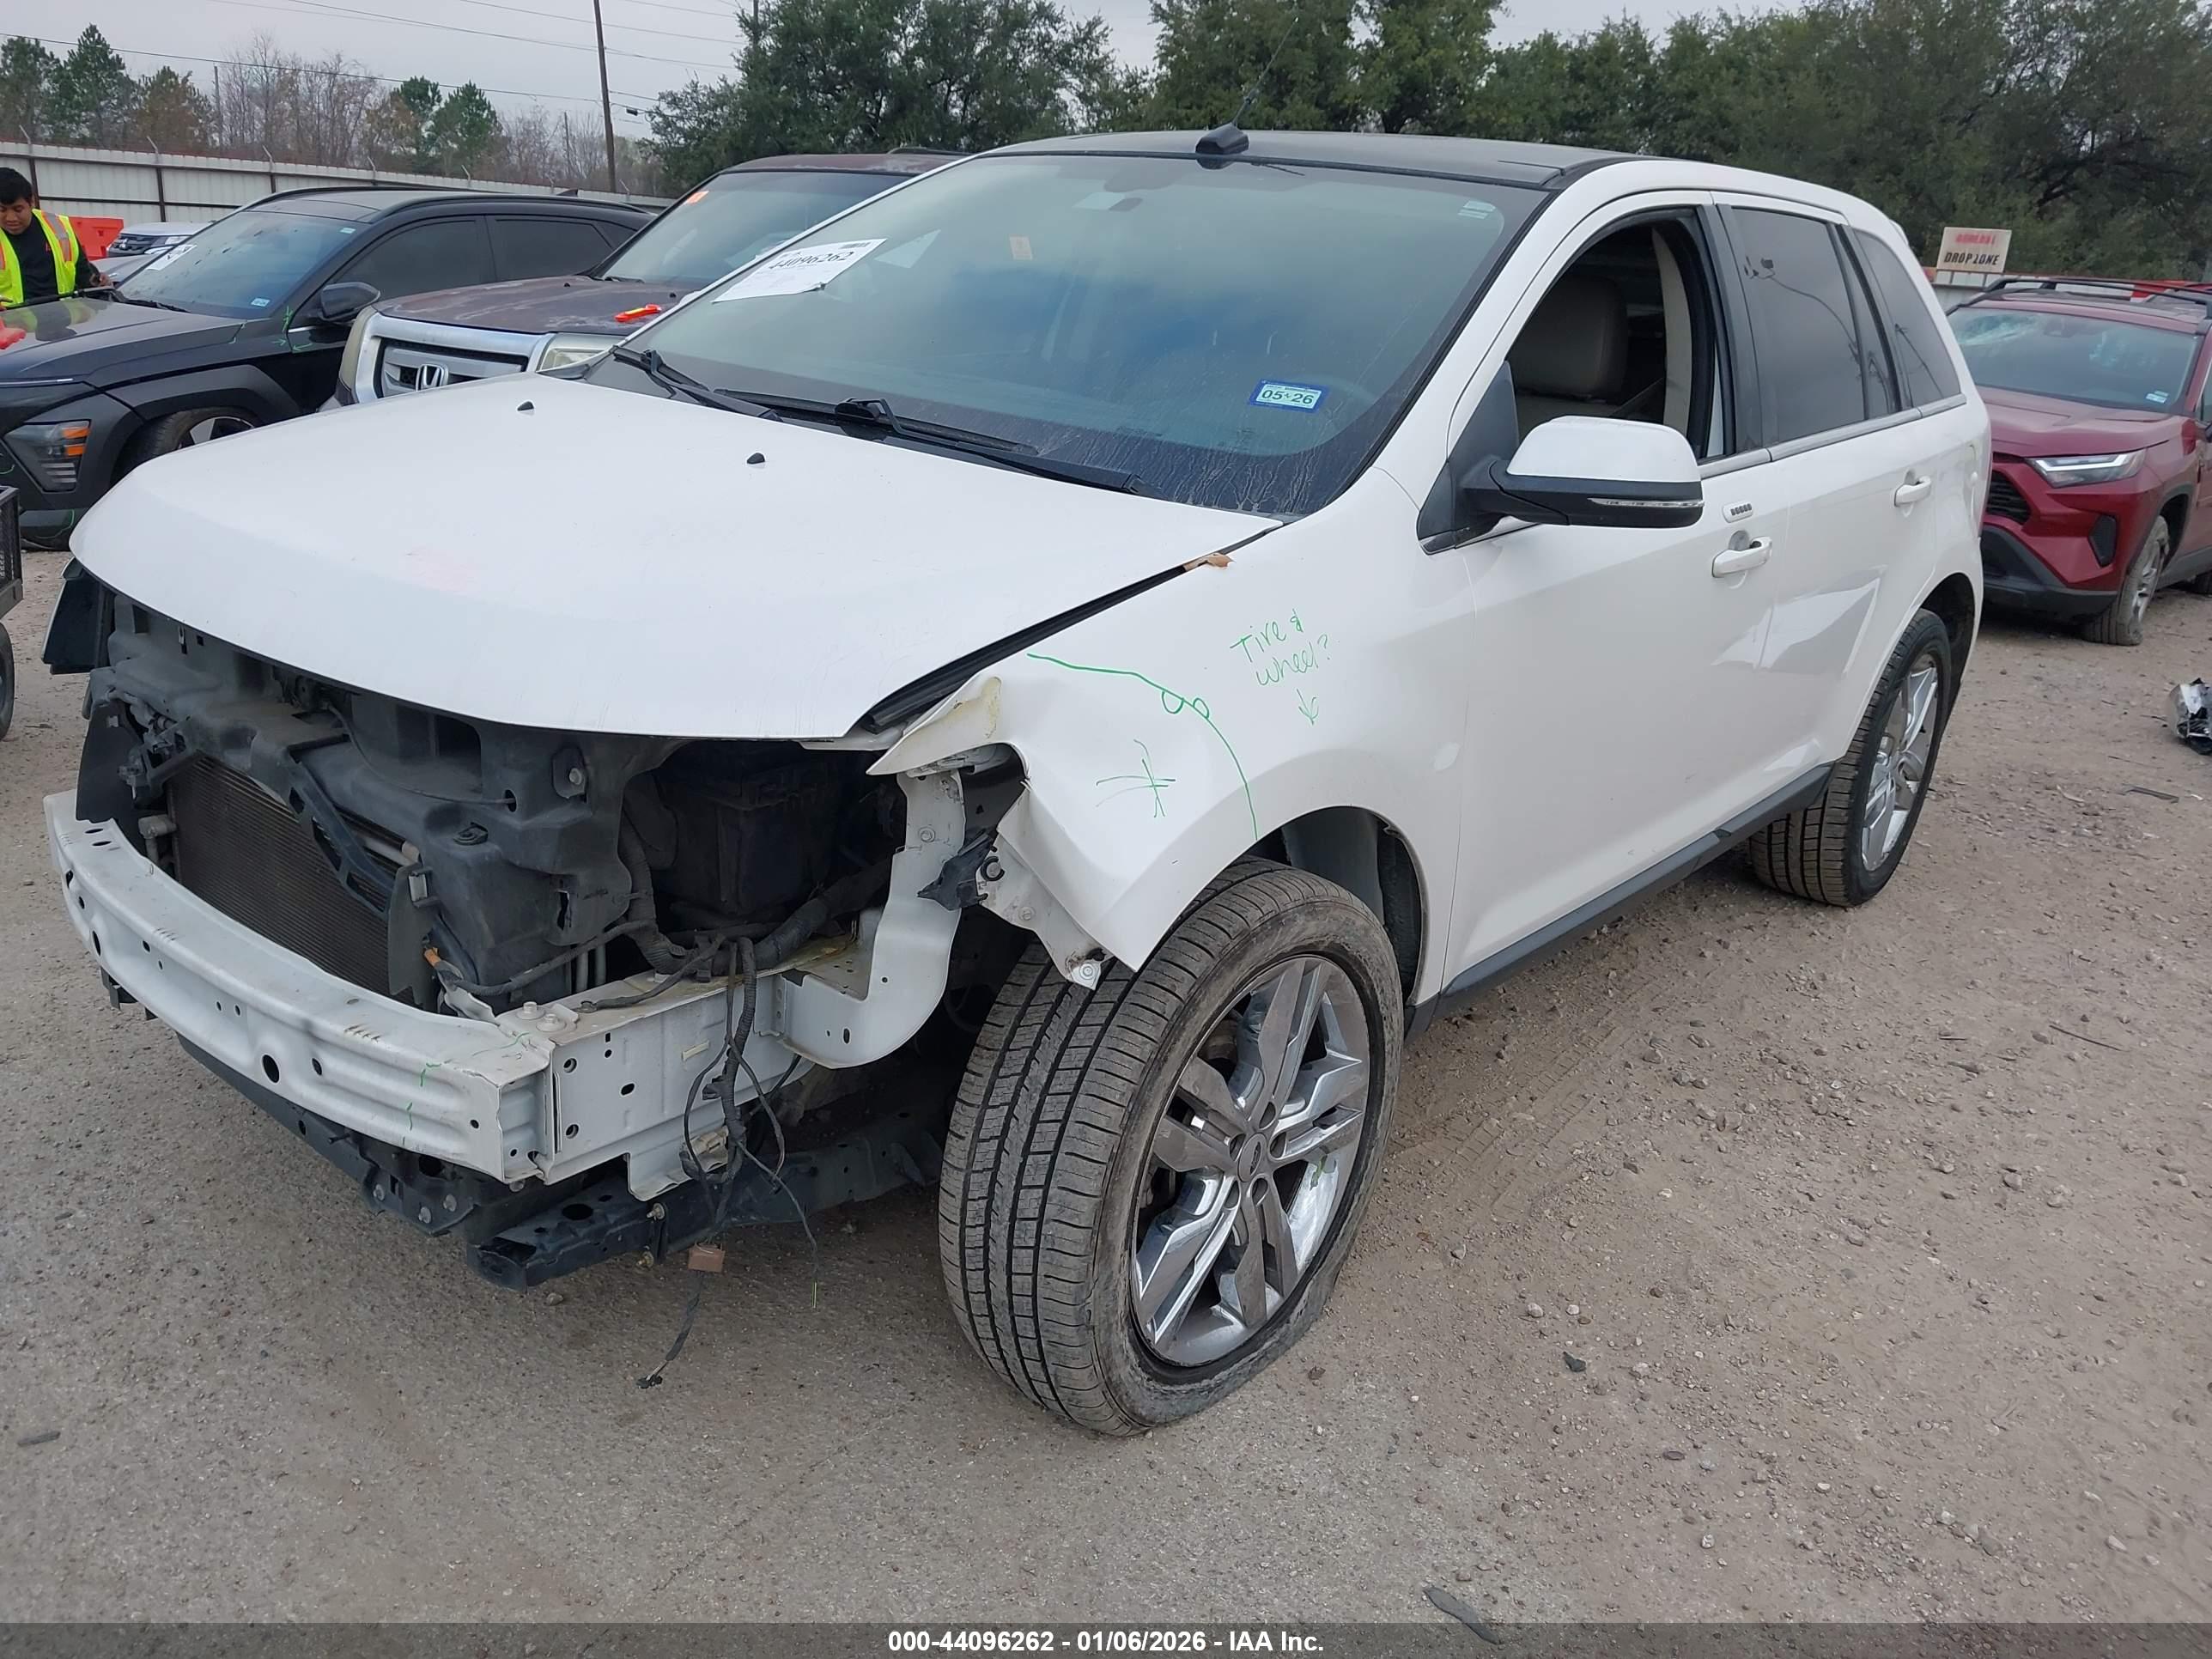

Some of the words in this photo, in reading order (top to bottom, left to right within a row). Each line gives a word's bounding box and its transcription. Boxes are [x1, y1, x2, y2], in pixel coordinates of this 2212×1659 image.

[1944, 252, 1973, 264] DROP
[1972, 253, 2000, 265] ZONE
[1261, 389, 1285, 400] 05
[1291, 392, 1315, 404] 26
[1230, 621, 1287, 663] Tire
